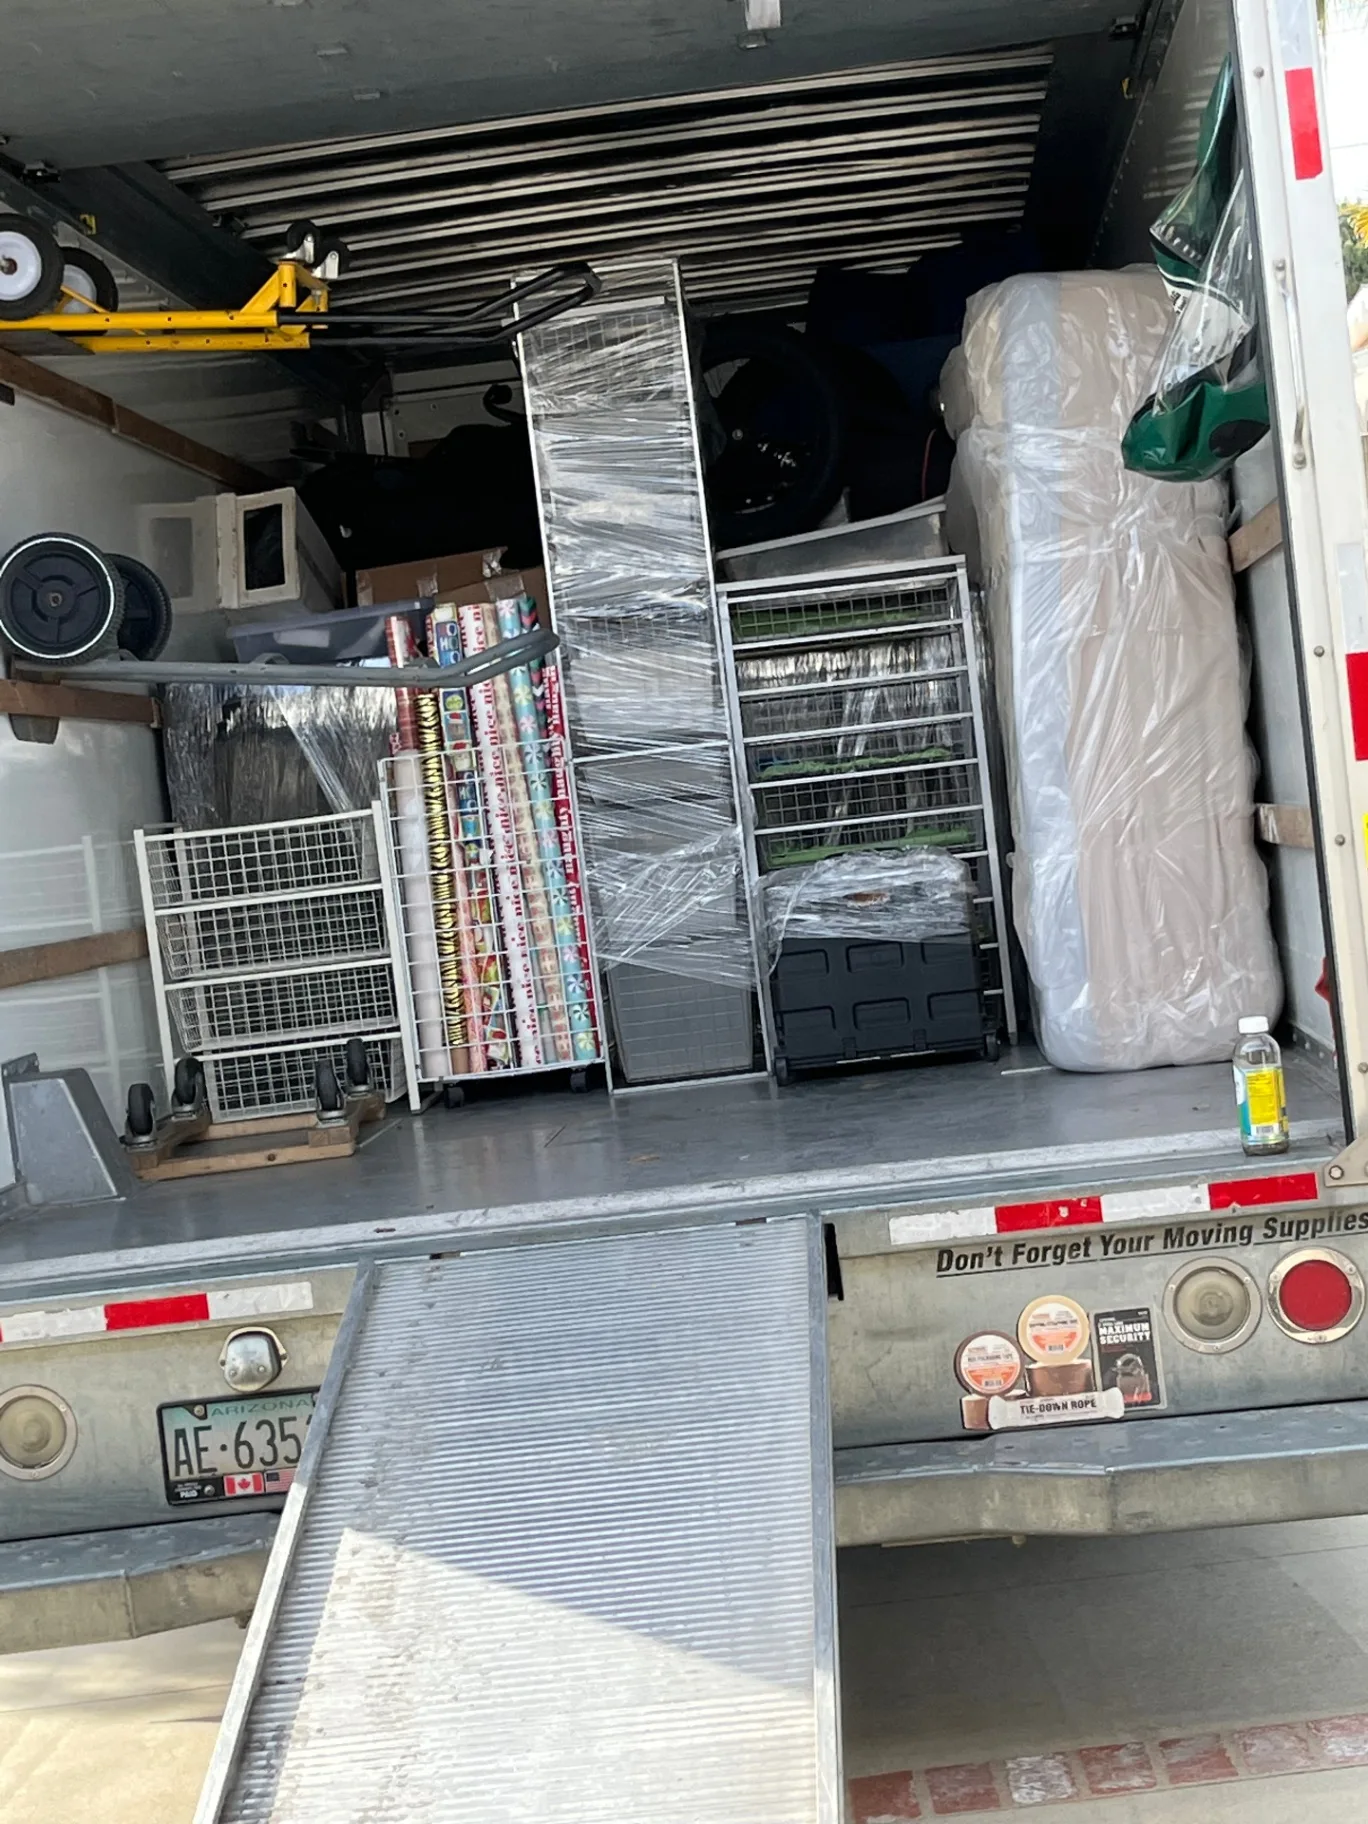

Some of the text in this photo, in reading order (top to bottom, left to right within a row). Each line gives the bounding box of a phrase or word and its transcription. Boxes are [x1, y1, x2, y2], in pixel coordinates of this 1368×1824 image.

[473, 626, 486, 652] ice
[485, 710, 499, 746] nice
[936, 1209, 1368, 1273] Don't Forget Your Moving Supplies
[1098, 1322, 1149, 1336] MAXIMUM
[1099, 1331, 1150, 1345] SECURITY
[210, 1400, 308, 1417] ARIZONA
[1070, 1399, 1097, 1410] ROPE
